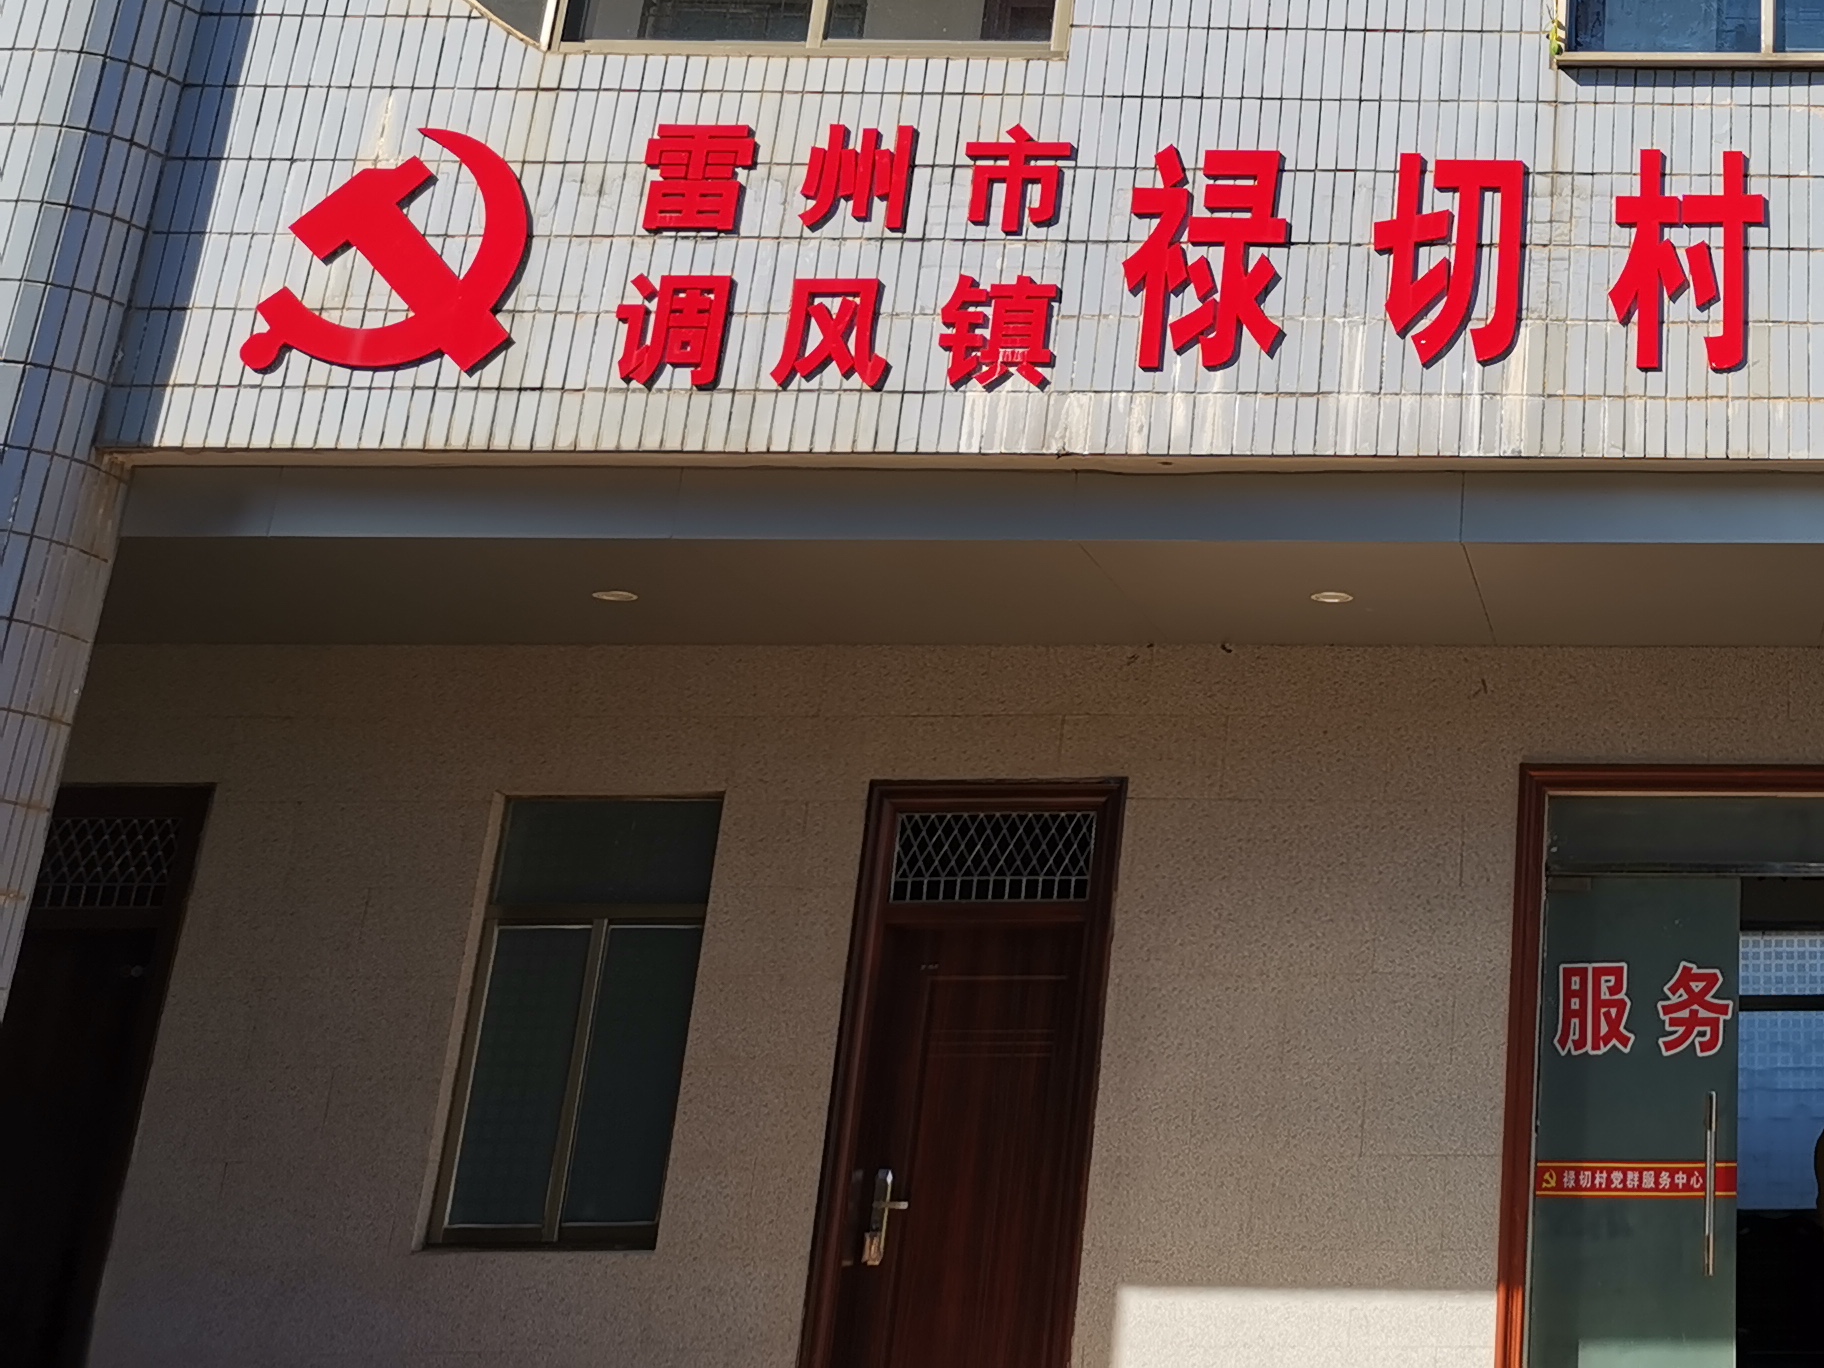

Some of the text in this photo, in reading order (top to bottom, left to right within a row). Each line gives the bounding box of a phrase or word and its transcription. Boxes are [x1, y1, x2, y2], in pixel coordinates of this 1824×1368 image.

[641, 123, 1073, 234] 雷州市
[615, 273, 1060, 389] 调风镇
[1554, 960, 1734, 1057] 服务
[1562, 1169, 1704, 1190] 禄切村党群服务中心
